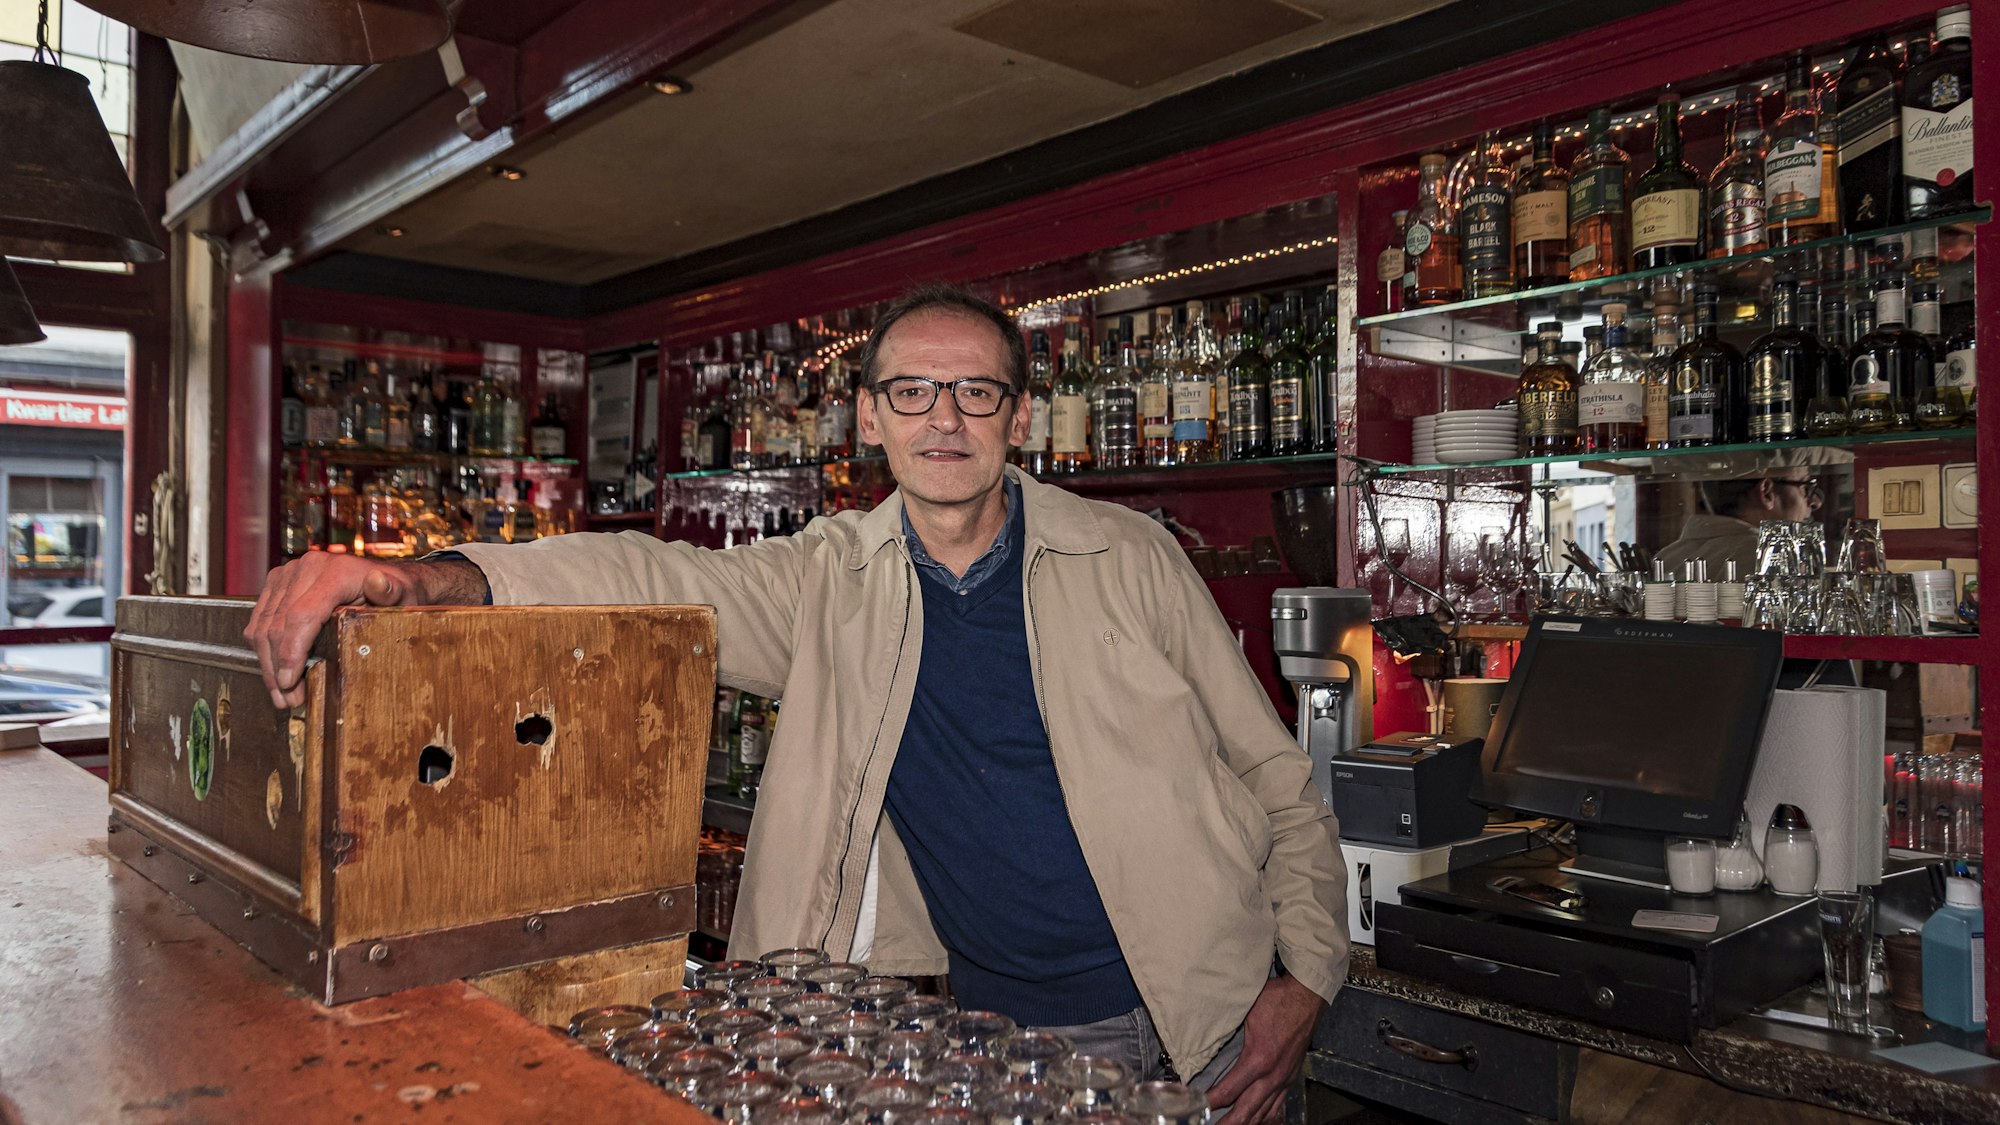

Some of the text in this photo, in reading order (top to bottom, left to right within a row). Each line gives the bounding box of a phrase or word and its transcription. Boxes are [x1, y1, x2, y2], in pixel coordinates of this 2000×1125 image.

[1929, 133, 1962, 143] FINEST
[1463, 192, 1506, 211] JAMESON
[1736, 198, 1766, 209] REGAL
[1469, 221, 1497, 234] BLACK
[1642, 225, 1656, 234] 12
[1468, 236, 1501, 249] BARREL
[1580, 394, 1624, 405] STRATHISLA
[6, 399, 94, 423] Kwartier
[1545, 411, 1557, 421] 12
[1592, 408, 1605, 416] 12
[1335, 771, 1354, 779] EPSON
